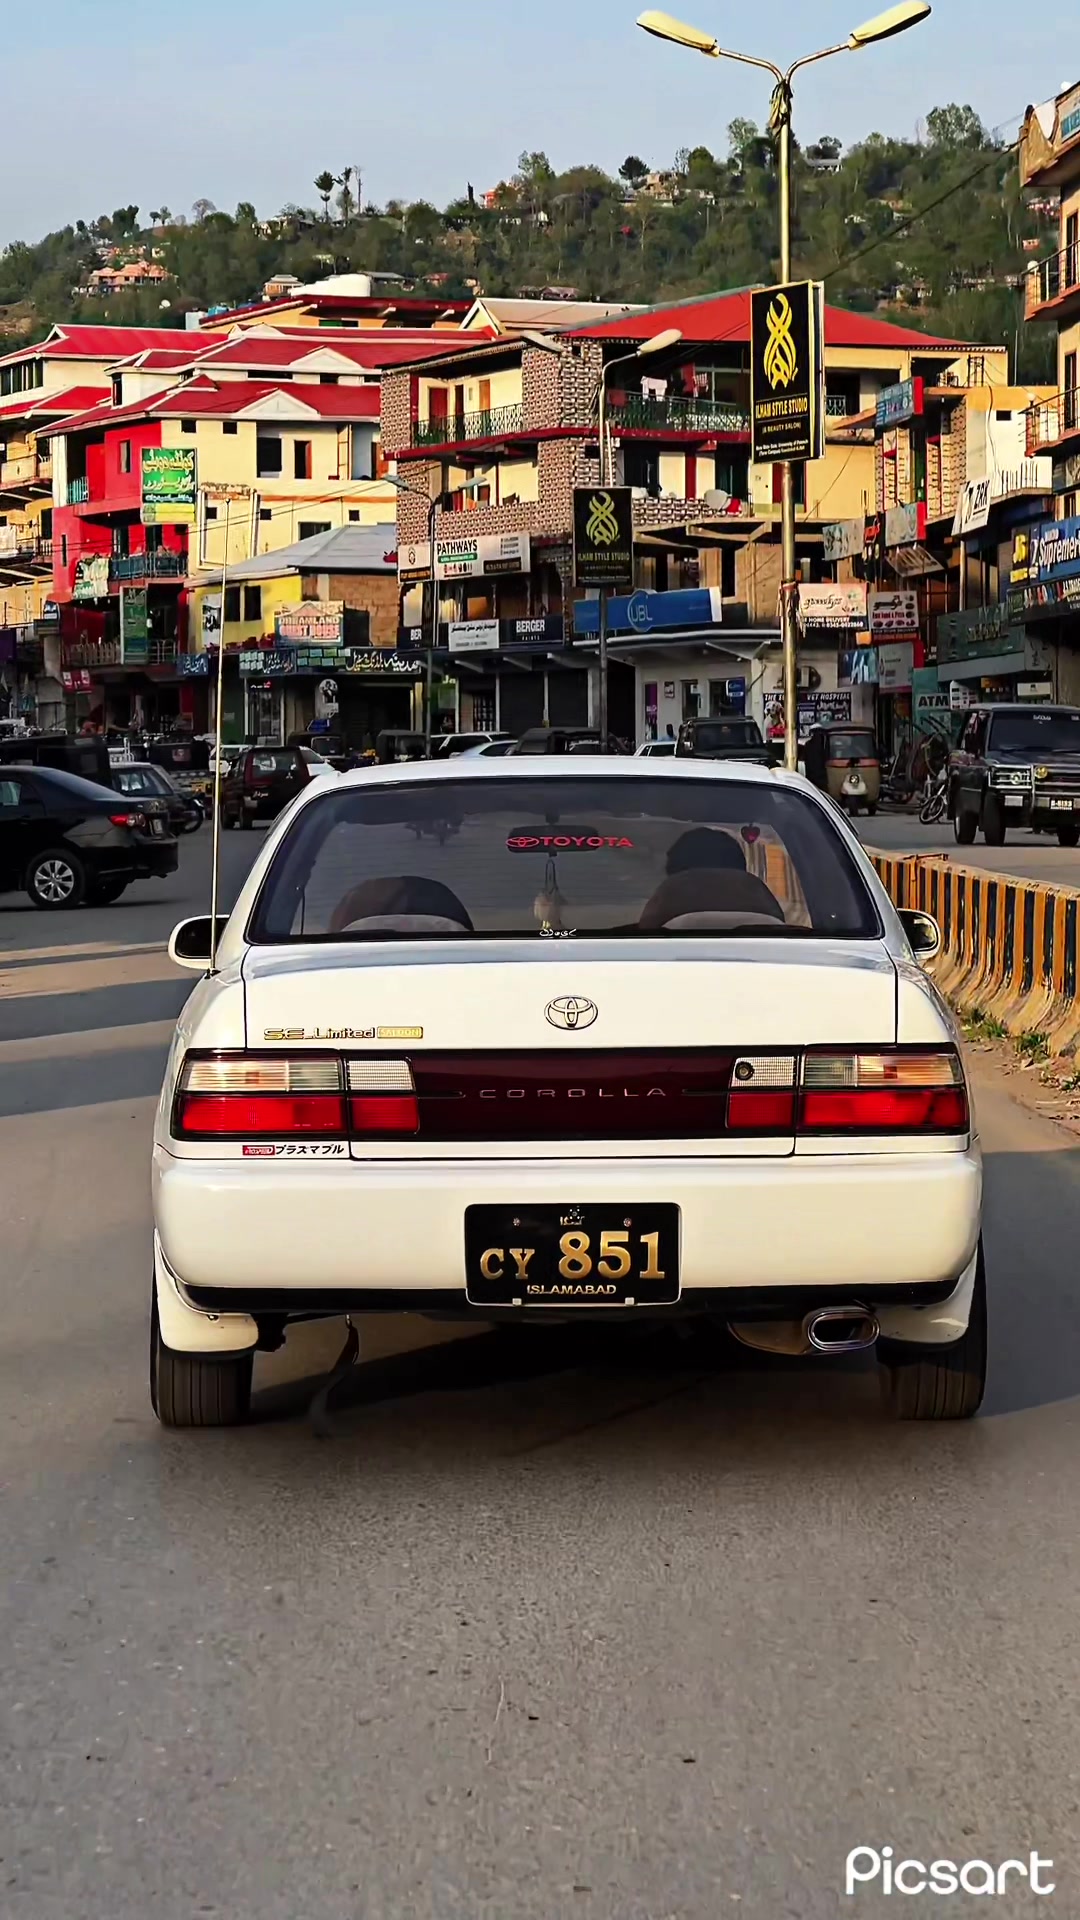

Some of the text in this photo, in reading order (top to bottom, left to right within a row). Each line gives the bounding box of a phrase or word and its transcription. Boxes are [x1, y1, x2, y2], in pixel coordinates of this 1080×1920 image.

[756, 397, 807, 419] ILHAM STYLE STUDIO
[974, 479, 990, 510] ZRK
[437, 539, 478, 555] PATHWAYS
[594, 552, 610, 561] STYLE
[611, 552, 630, 561] STUDIO
[630, 604, 653, 622] UBL
[516, 619, 545, 633] BERGER
[820, 692, 850, 700] HOSPITAL
[918, 694, 949, 709] ATM
[540, 836, 633, 847] TOYOTA
[314, 1026, 376, 1039] Limited
[379, 1029, 420, 1038] SALOON
[479, 1087, 666, 1099] COROLLA
[480, 1230, 666, 1280] CY 851
[526, 1283, 617, 1295] ISLAMABAD
